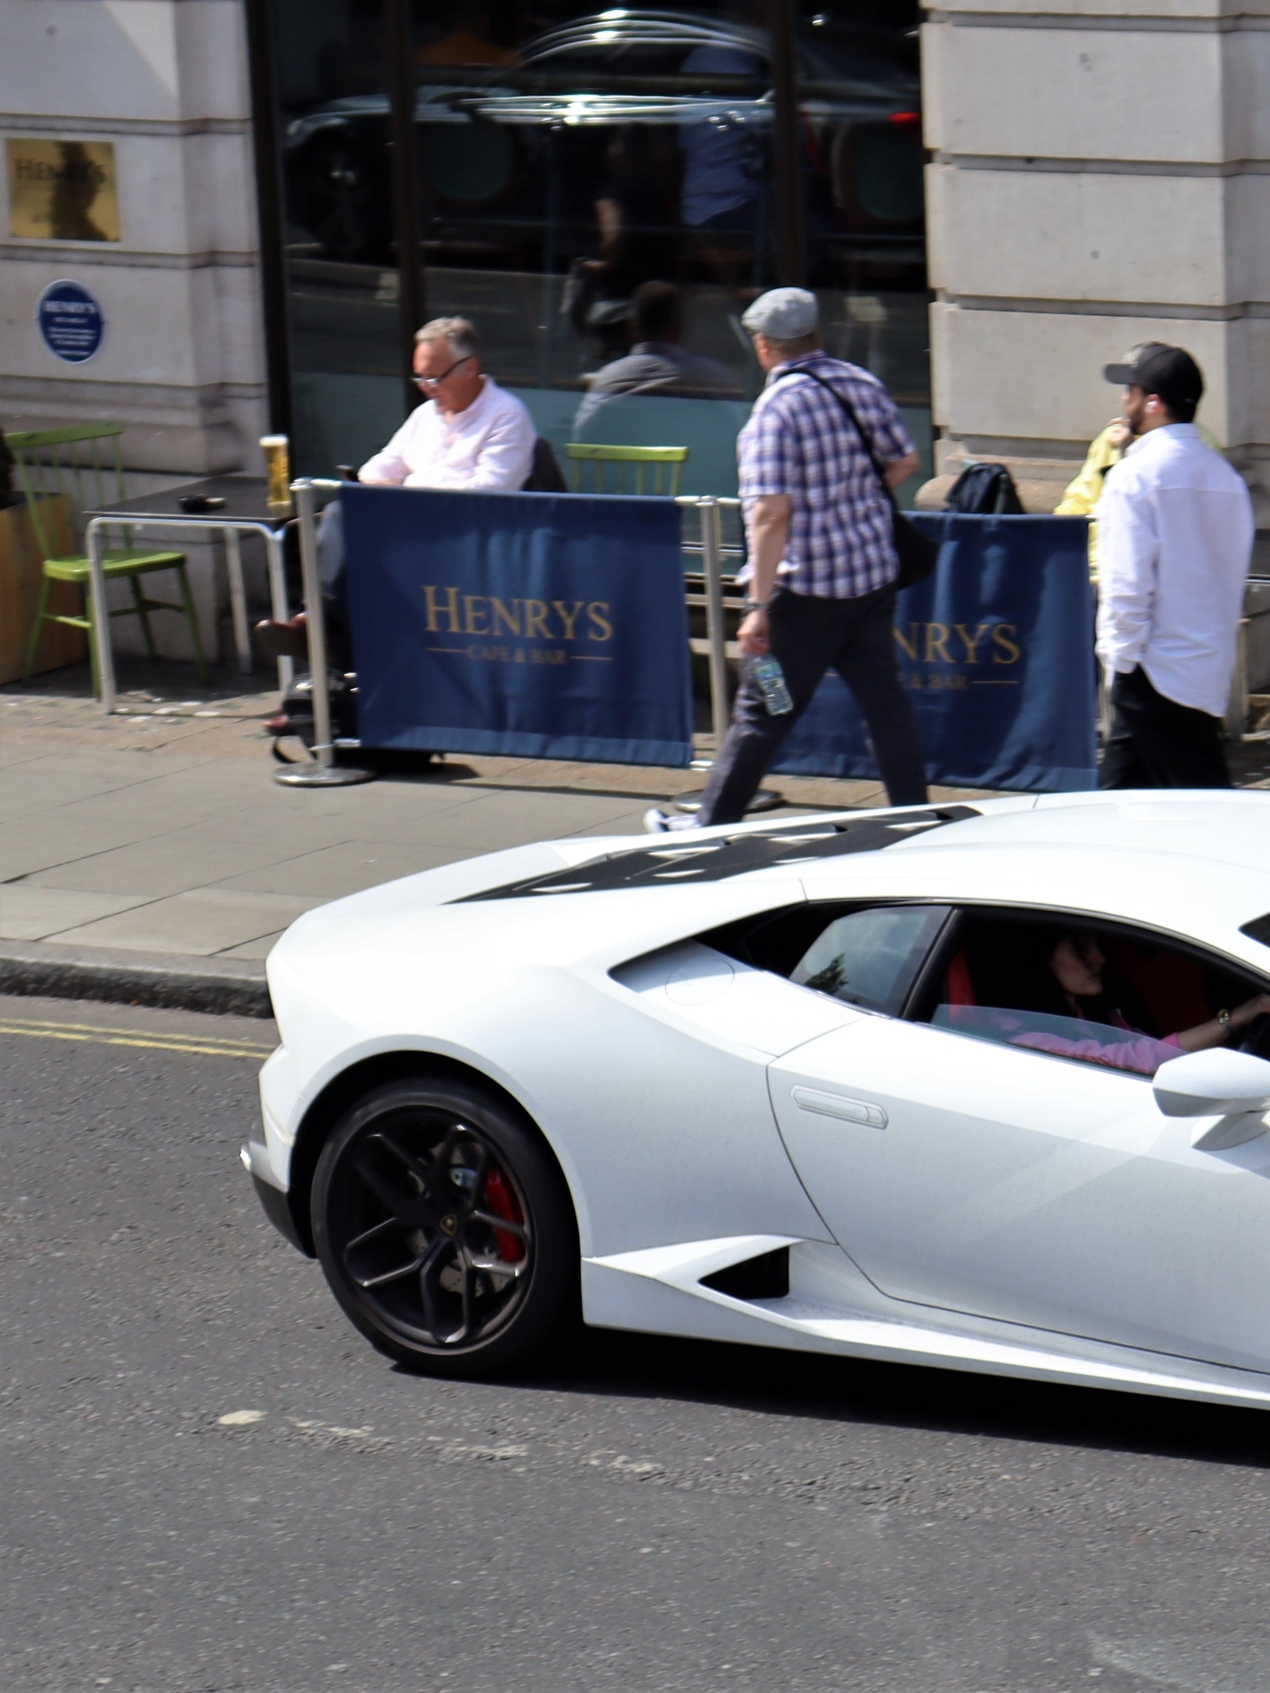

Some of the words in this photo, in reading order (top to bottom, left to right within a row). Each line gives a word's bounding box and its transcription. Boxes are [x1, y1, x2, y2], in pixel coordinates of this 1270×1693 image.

[421, 585, 614, 642] HENRYS
[513, 646, 527, 663] &
[531, 647, 568, 665] BAR
[892, 622, 1021, 664] NRYS
[927, 672, 969, 690] BAR
